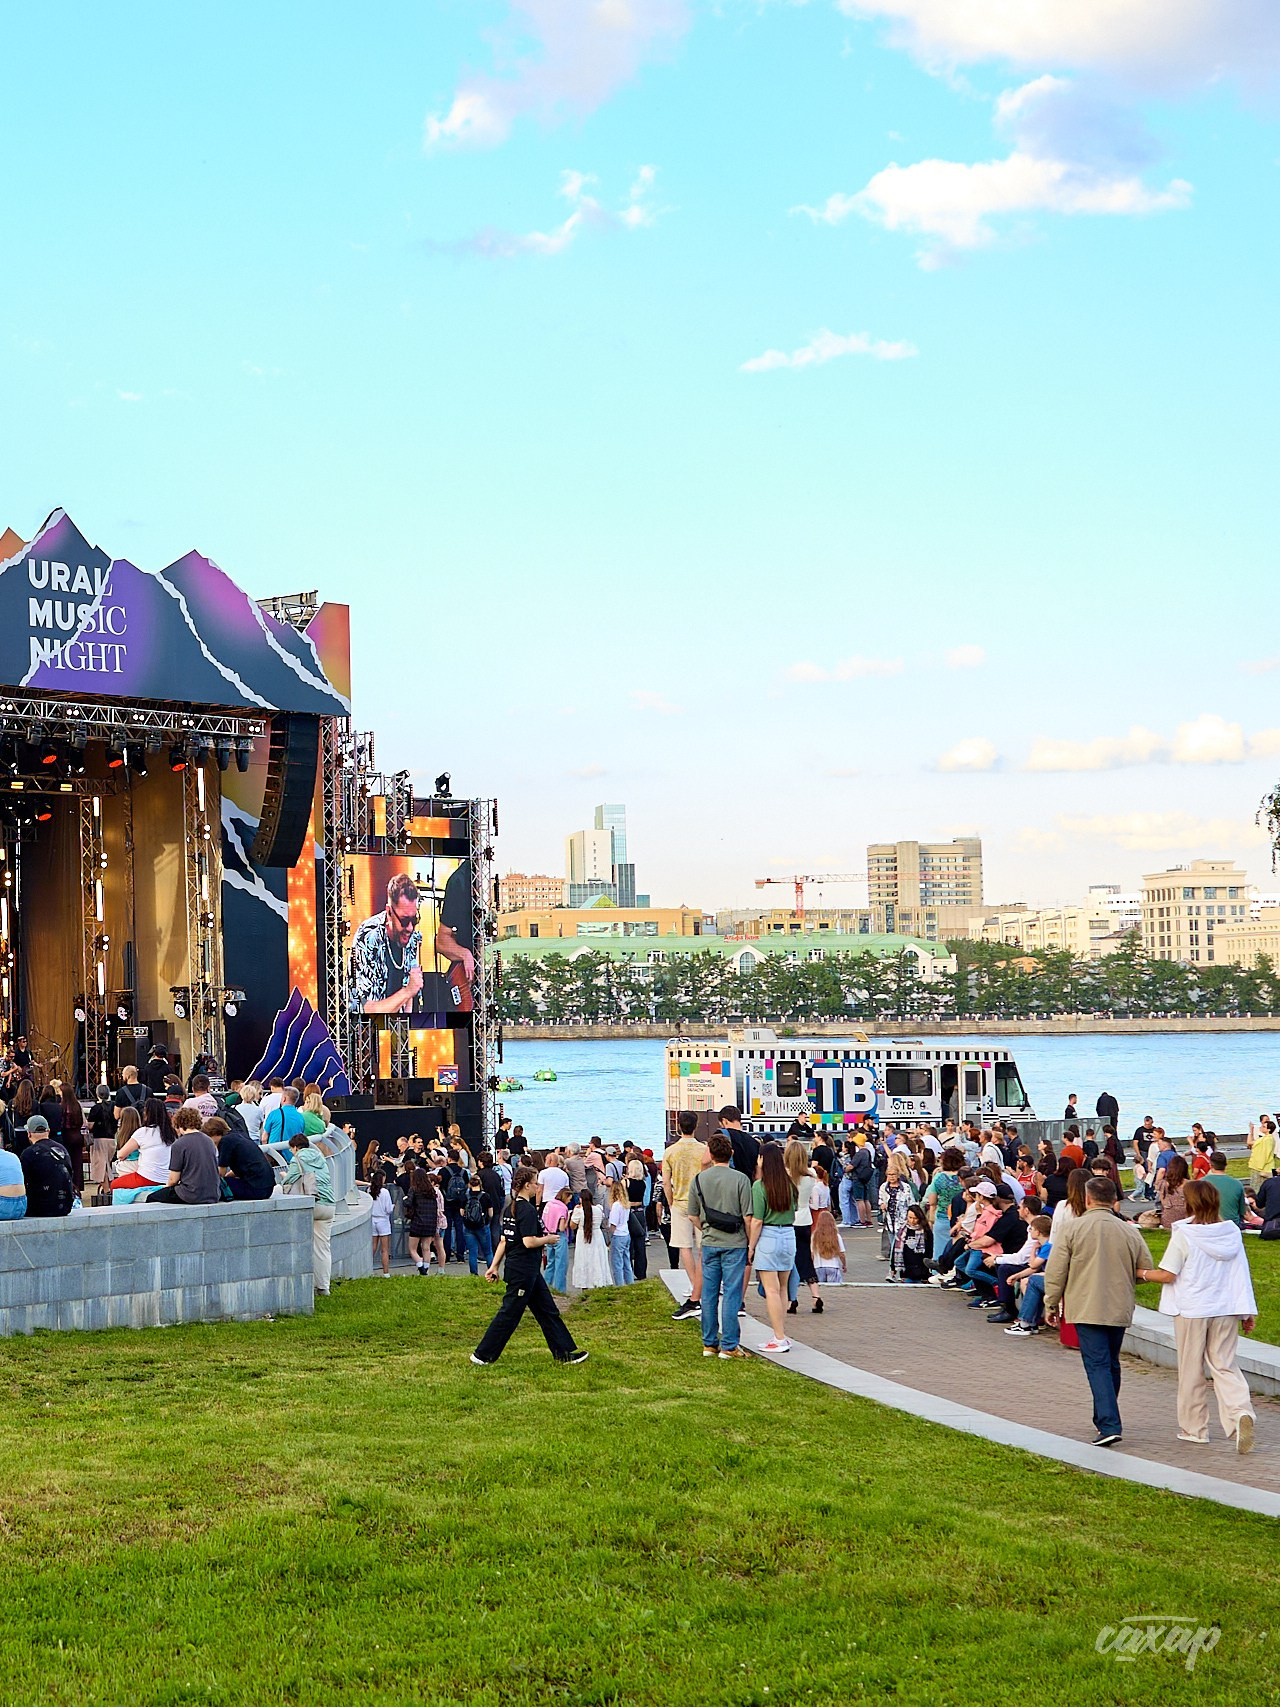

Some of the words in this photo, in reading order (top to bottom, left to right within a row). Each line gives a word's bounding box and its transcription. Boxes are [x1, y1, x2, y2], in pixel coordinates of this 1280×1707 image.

[28, 558, 113, 596] URAL
[28, 597, 127, 636] MUSIC
[29, 636, 127, 673] NIGHT
